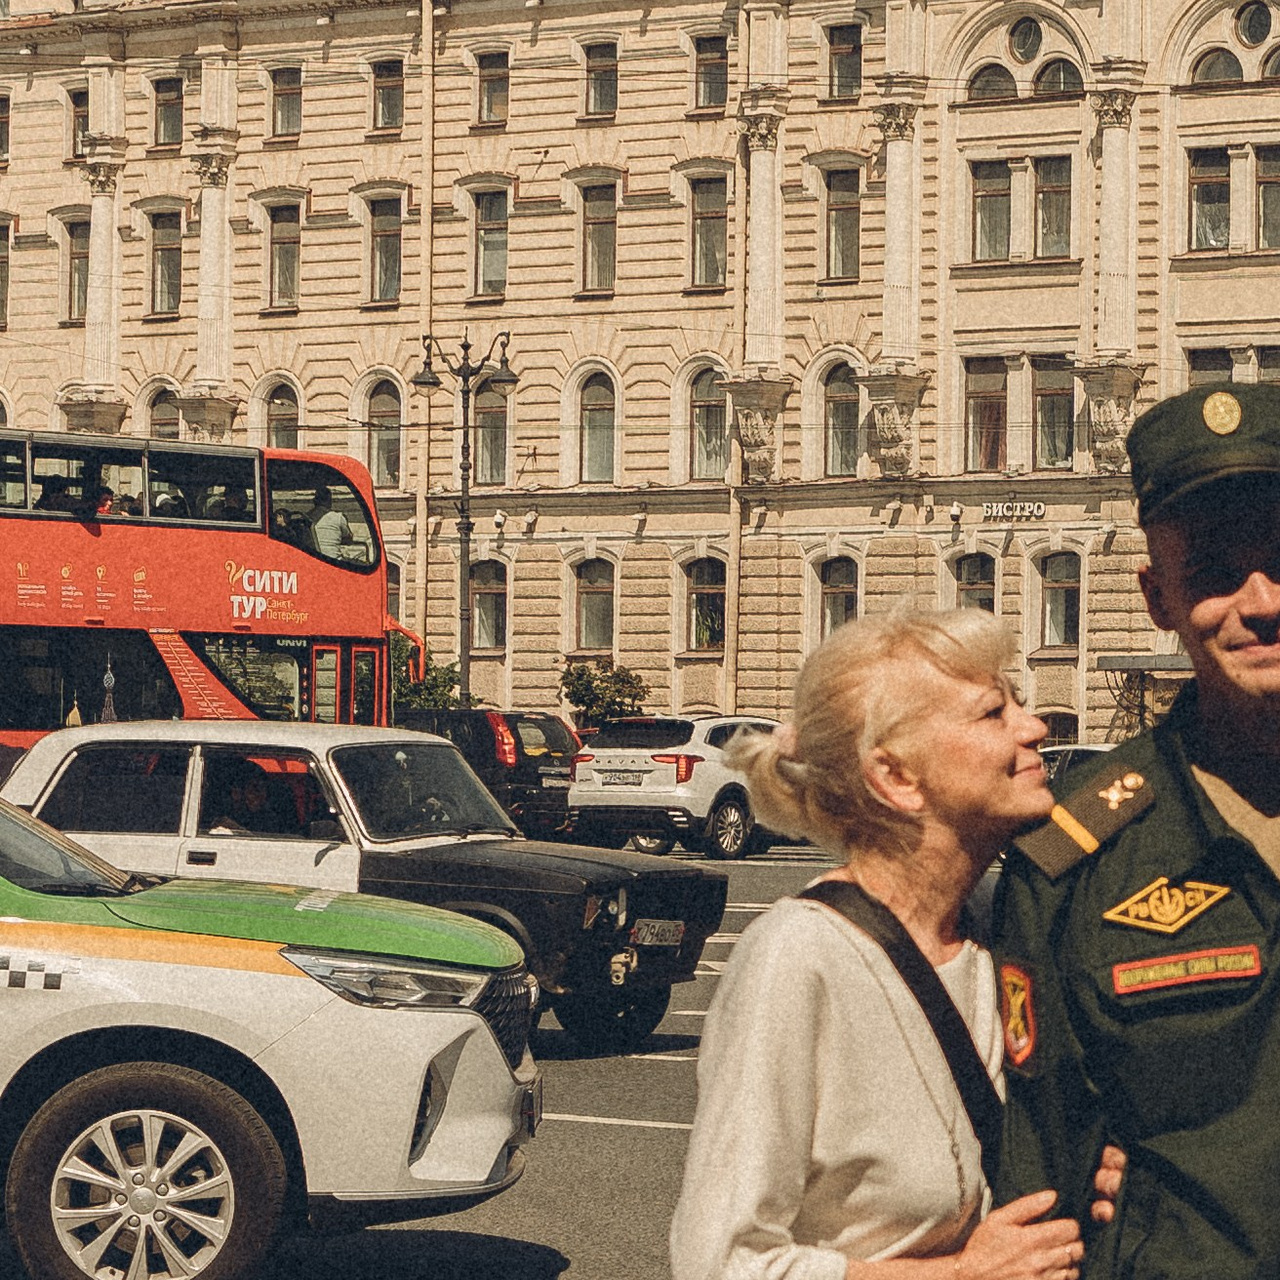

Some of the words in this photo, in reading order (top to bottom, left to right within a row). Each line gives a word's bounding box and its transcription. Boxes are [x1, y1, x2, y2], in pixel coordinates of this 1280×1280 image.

[981, 502, 1045, 517] БИСТРО
[242, 569, 298, 594] СИТИ
[230, 595, 267, 619] ТУР
[266, 597, 294, 608] Санкт-
[266, 608, 309, 624] Петербург
